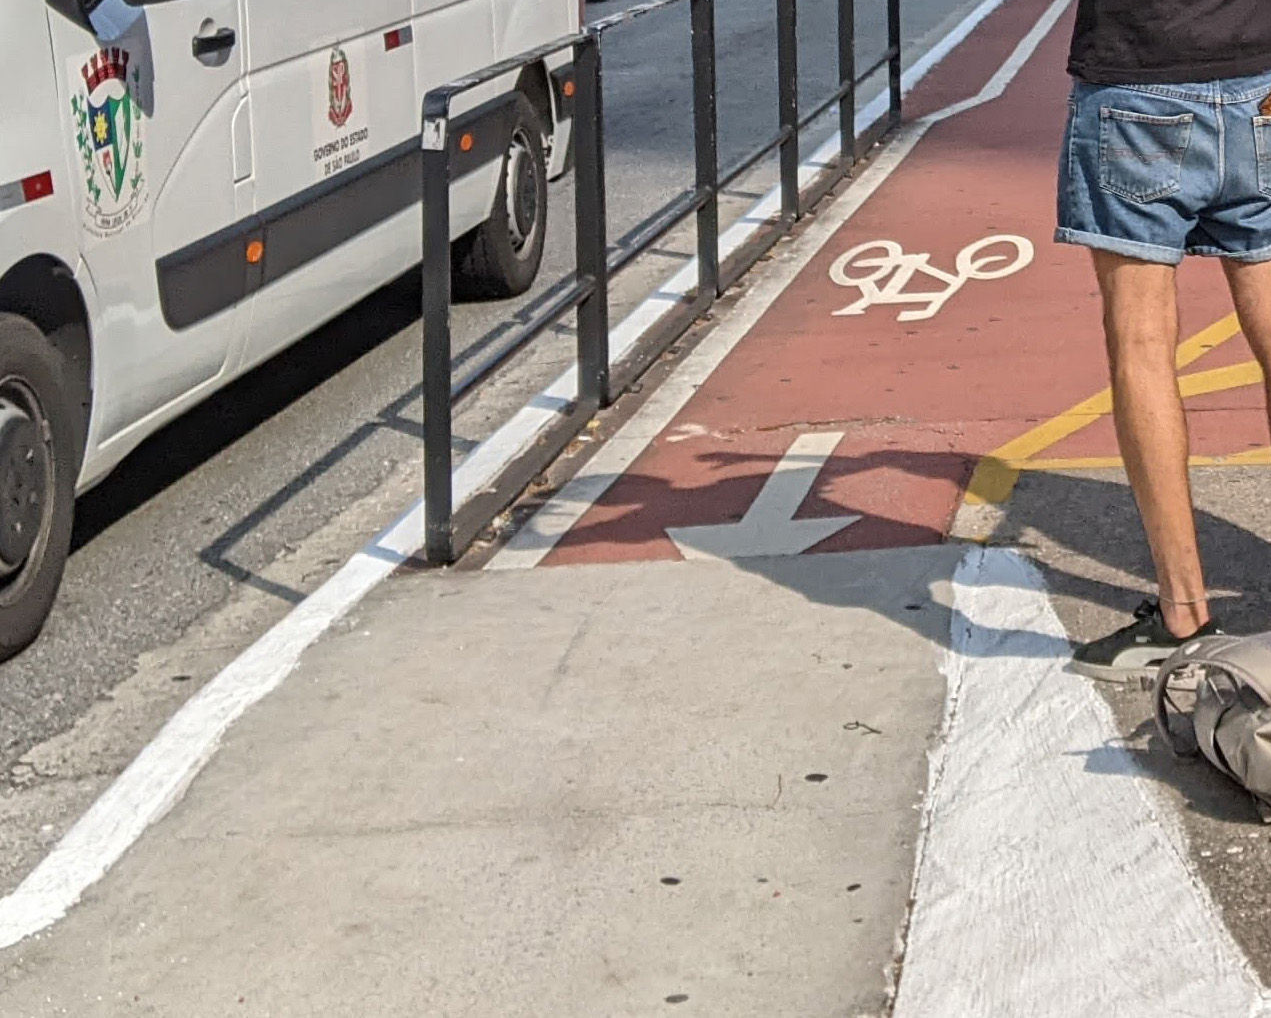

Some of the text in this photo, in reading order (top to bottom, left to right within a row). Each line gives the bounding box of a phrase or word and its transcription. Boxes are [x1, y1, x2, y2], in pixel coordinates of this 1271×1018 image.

[313, 126, 369, 162] GOVERNO DO ESTADO
